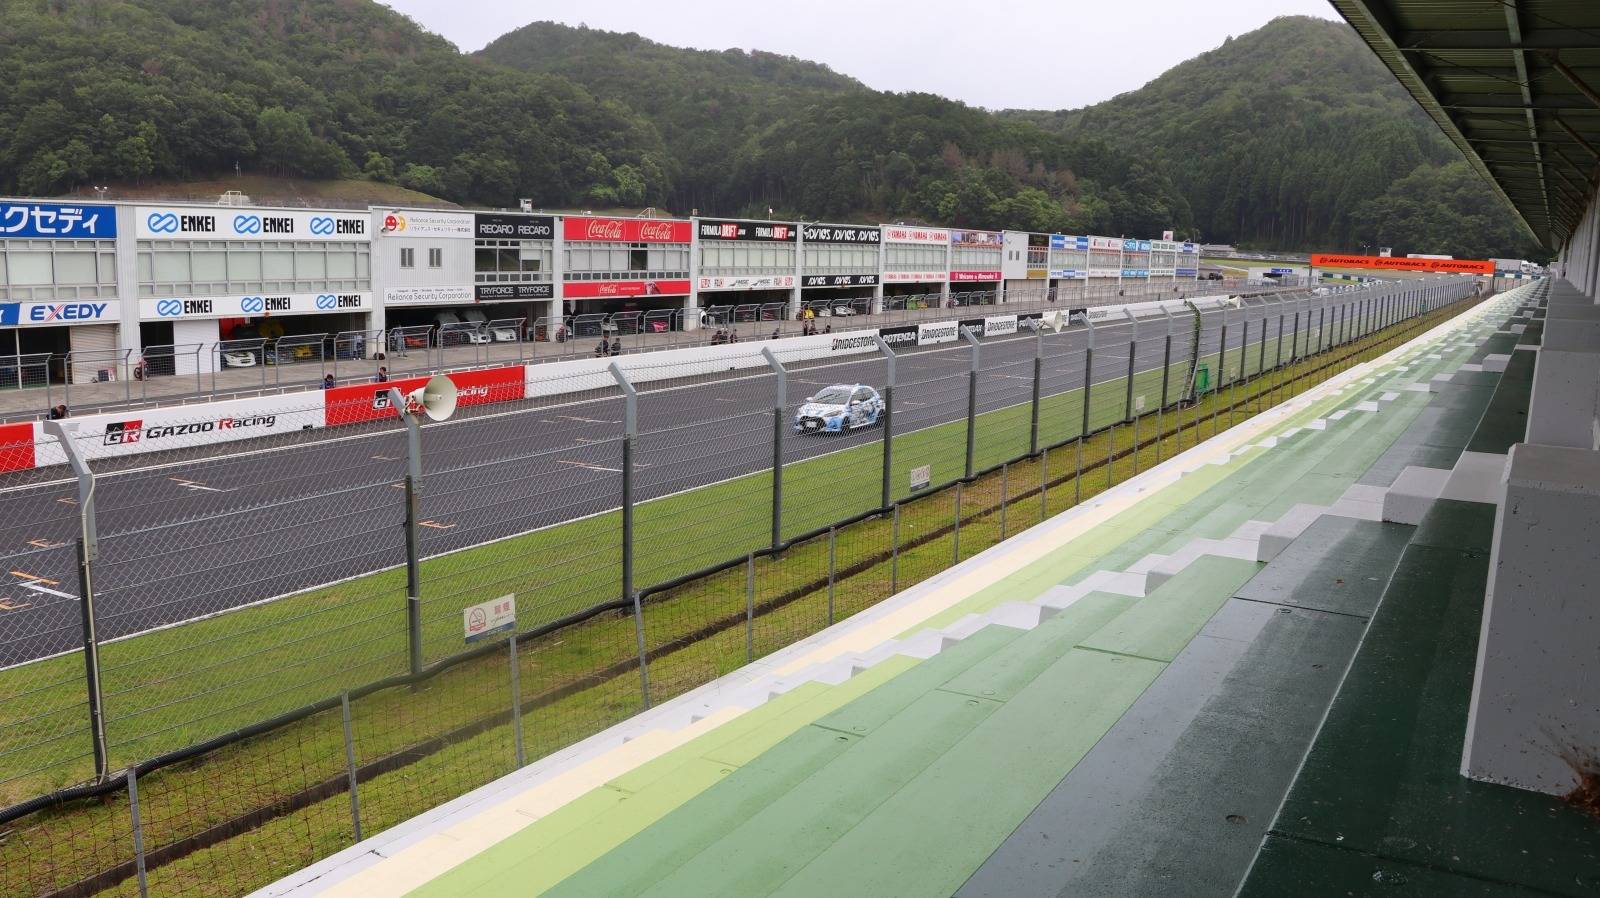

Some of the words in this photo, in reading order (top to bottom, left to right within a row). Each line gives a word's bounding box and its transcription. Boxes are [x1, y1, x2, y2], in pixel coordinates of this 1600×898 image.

[181, 216, 216, 232] ENKEI
[263, 218, 294, 233] ENKEI
[336, 219, 365, 235] ENKEI
[480, 224, 514, 234] RECARO
[518, 225, 550, 235] RECARO
[701, 225, 721, 236] FORMULA
[722, 225, 737, 238] DRIFT
[756, 227, 773, 237] FORMULA
[774, 227, 787, 239] DRIFT
[1441, 262, 1484, 270] AUTOBACS
[338, 295, 361, 307] ENKEI
[388, 293, 413, 301] Reliance
[414, 292, 438, 300] Security
[439, 291, 472, 300] Corporation
[184, 300, 212, 314] ENKEI
[265, 297, 291, 310] ENKEI
[30, 303, 107, 322] EXEDY
[921, 327, 957, 340] BRIDGESTONE
[455, 387, 488, 397] acing
[104, 431, 141, 444] GR
[146, 422, 214, 439] GAZOO
[218, 416, 276, 430] Racing
